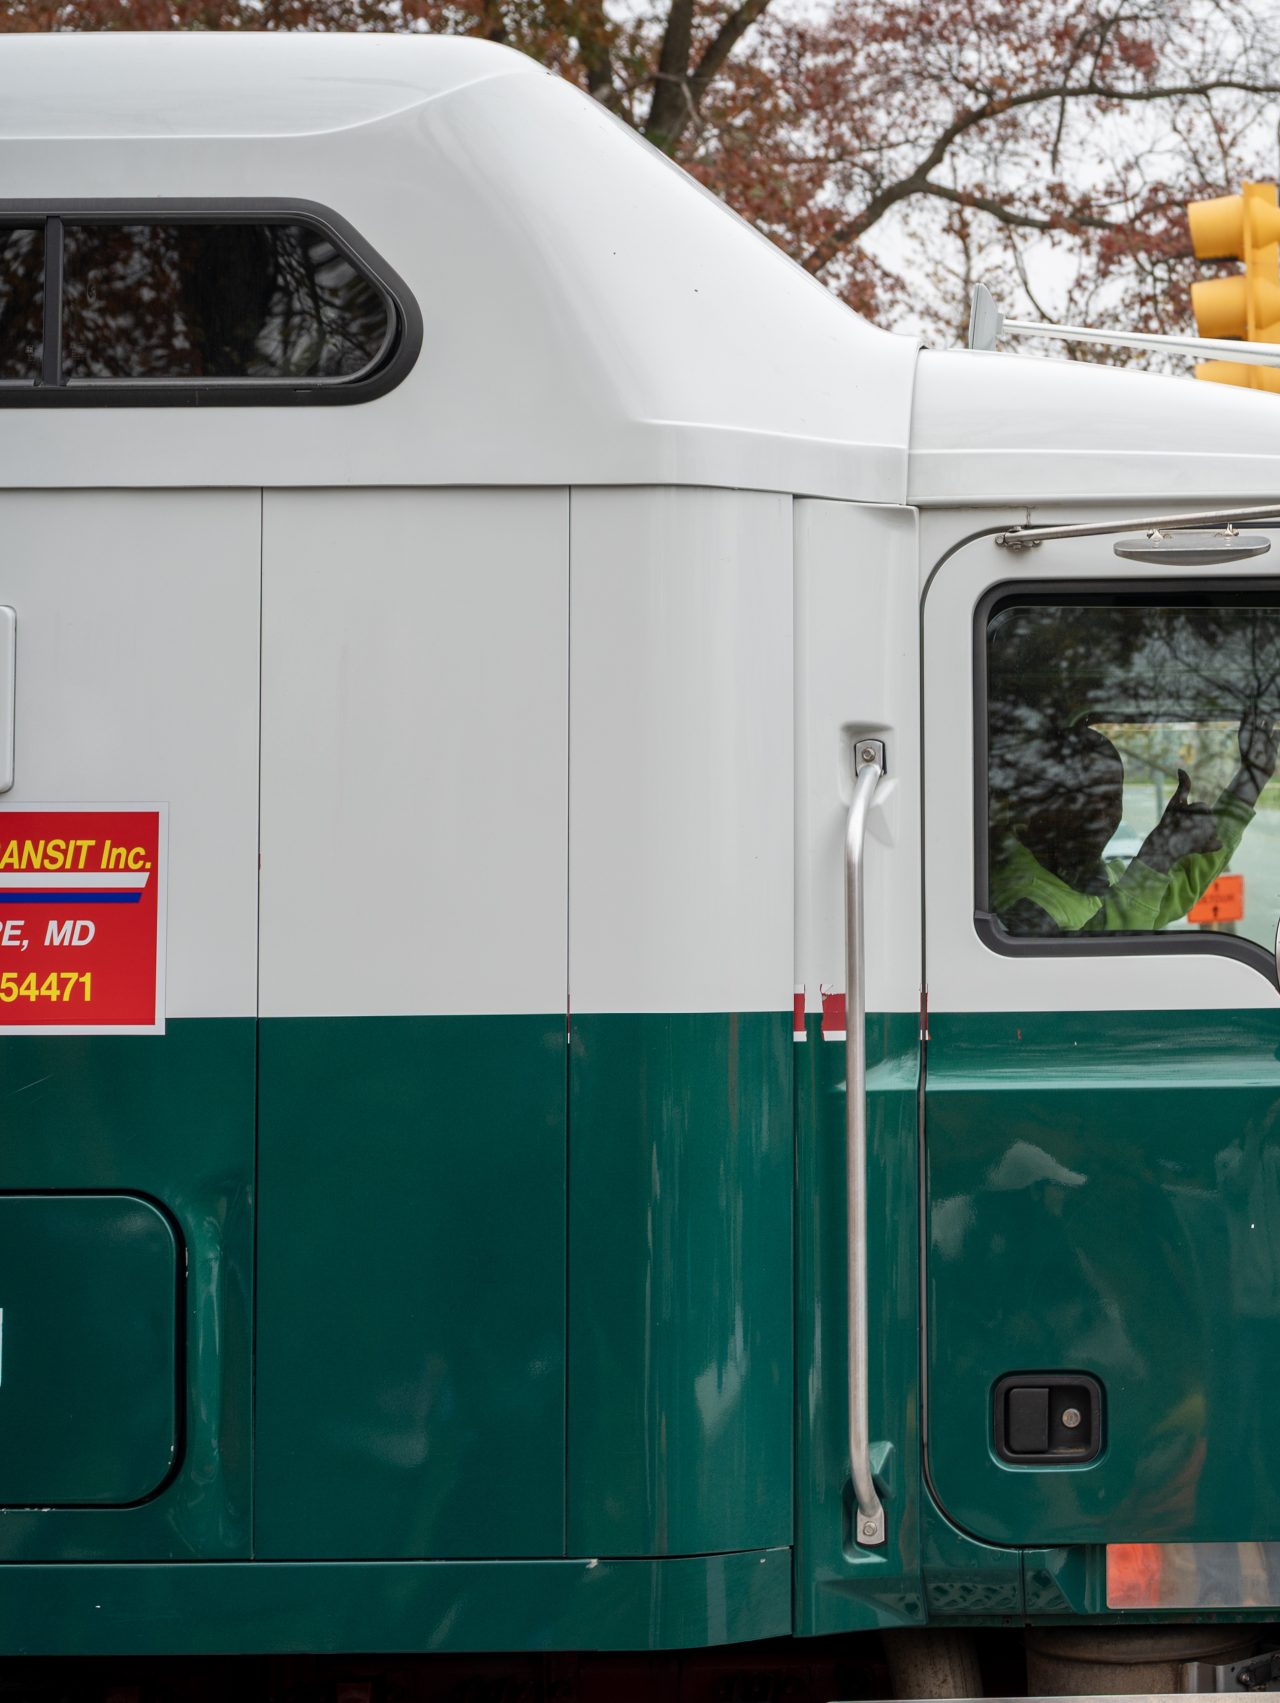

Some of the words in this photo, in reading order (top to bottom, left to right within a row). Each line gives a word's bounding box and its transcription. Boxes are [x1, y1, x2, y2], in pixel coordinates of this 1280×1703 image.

[0, 839, 96, 870] ANSIT
[100, 840, 152, 870] Inc.
[0, 920, 29, 952] E,
[44, 920, 96, 946] MD
[0, 972, 92, 1002] 54471
